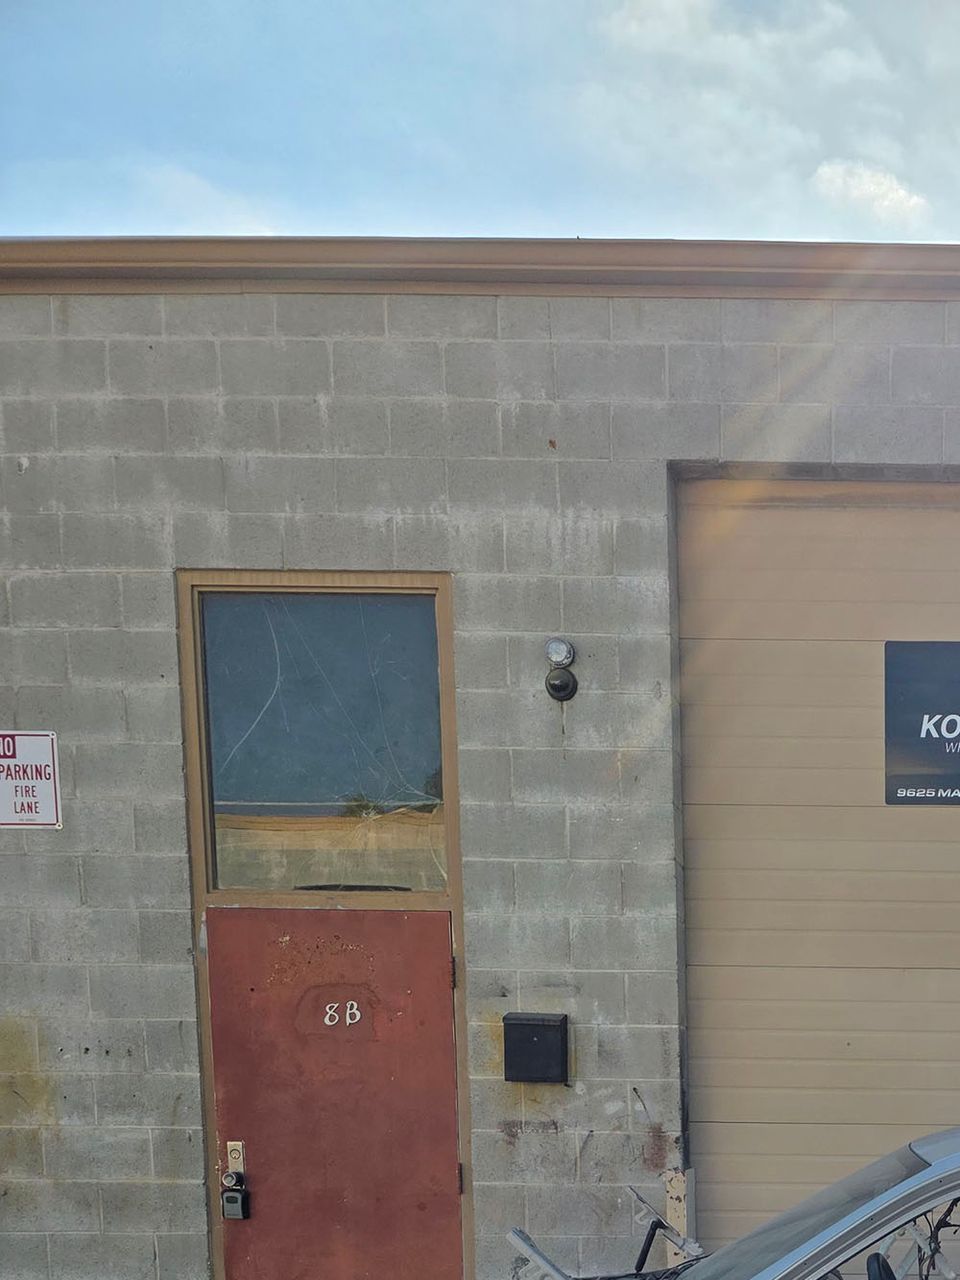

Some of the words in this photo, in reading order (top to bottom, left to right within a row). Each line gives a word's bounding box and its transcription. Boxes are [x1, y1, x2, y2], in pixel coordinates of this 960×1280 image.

[14, 785, 37, 798] FIRE
[897, 788, 936, 797] 9625
[14, 801, 40, 814] LANE
